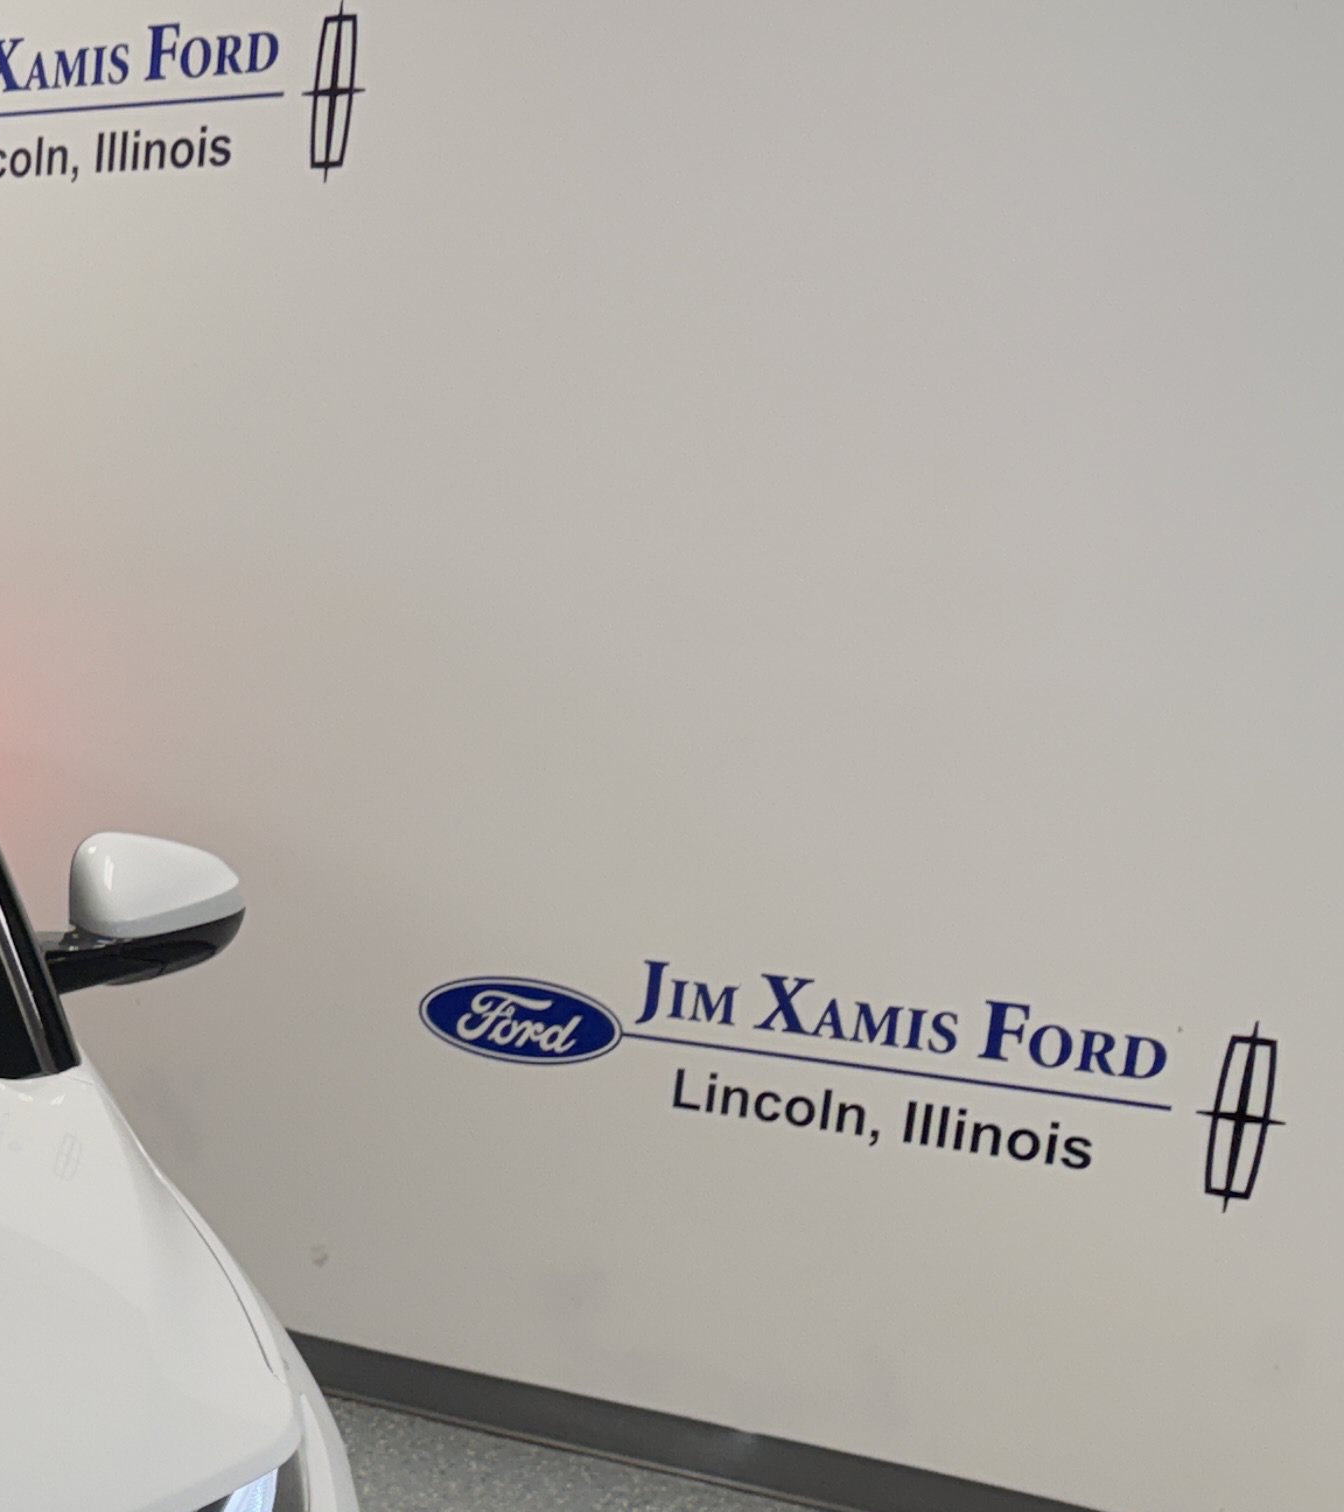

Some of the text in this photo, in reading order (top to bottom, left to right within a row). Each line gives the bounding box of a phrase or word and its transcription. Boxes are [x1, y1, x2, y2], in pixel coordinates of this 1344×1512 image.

[144, 22, 279, 81] FORD
[95, 126, 232, 173] Illinois
[456, 988, 581, 1055] Ford
[634, 959, 1169, 1081] JIM XAMIS FORD
[671, 1068, 1095, 1170] Lincoln, Illinois
